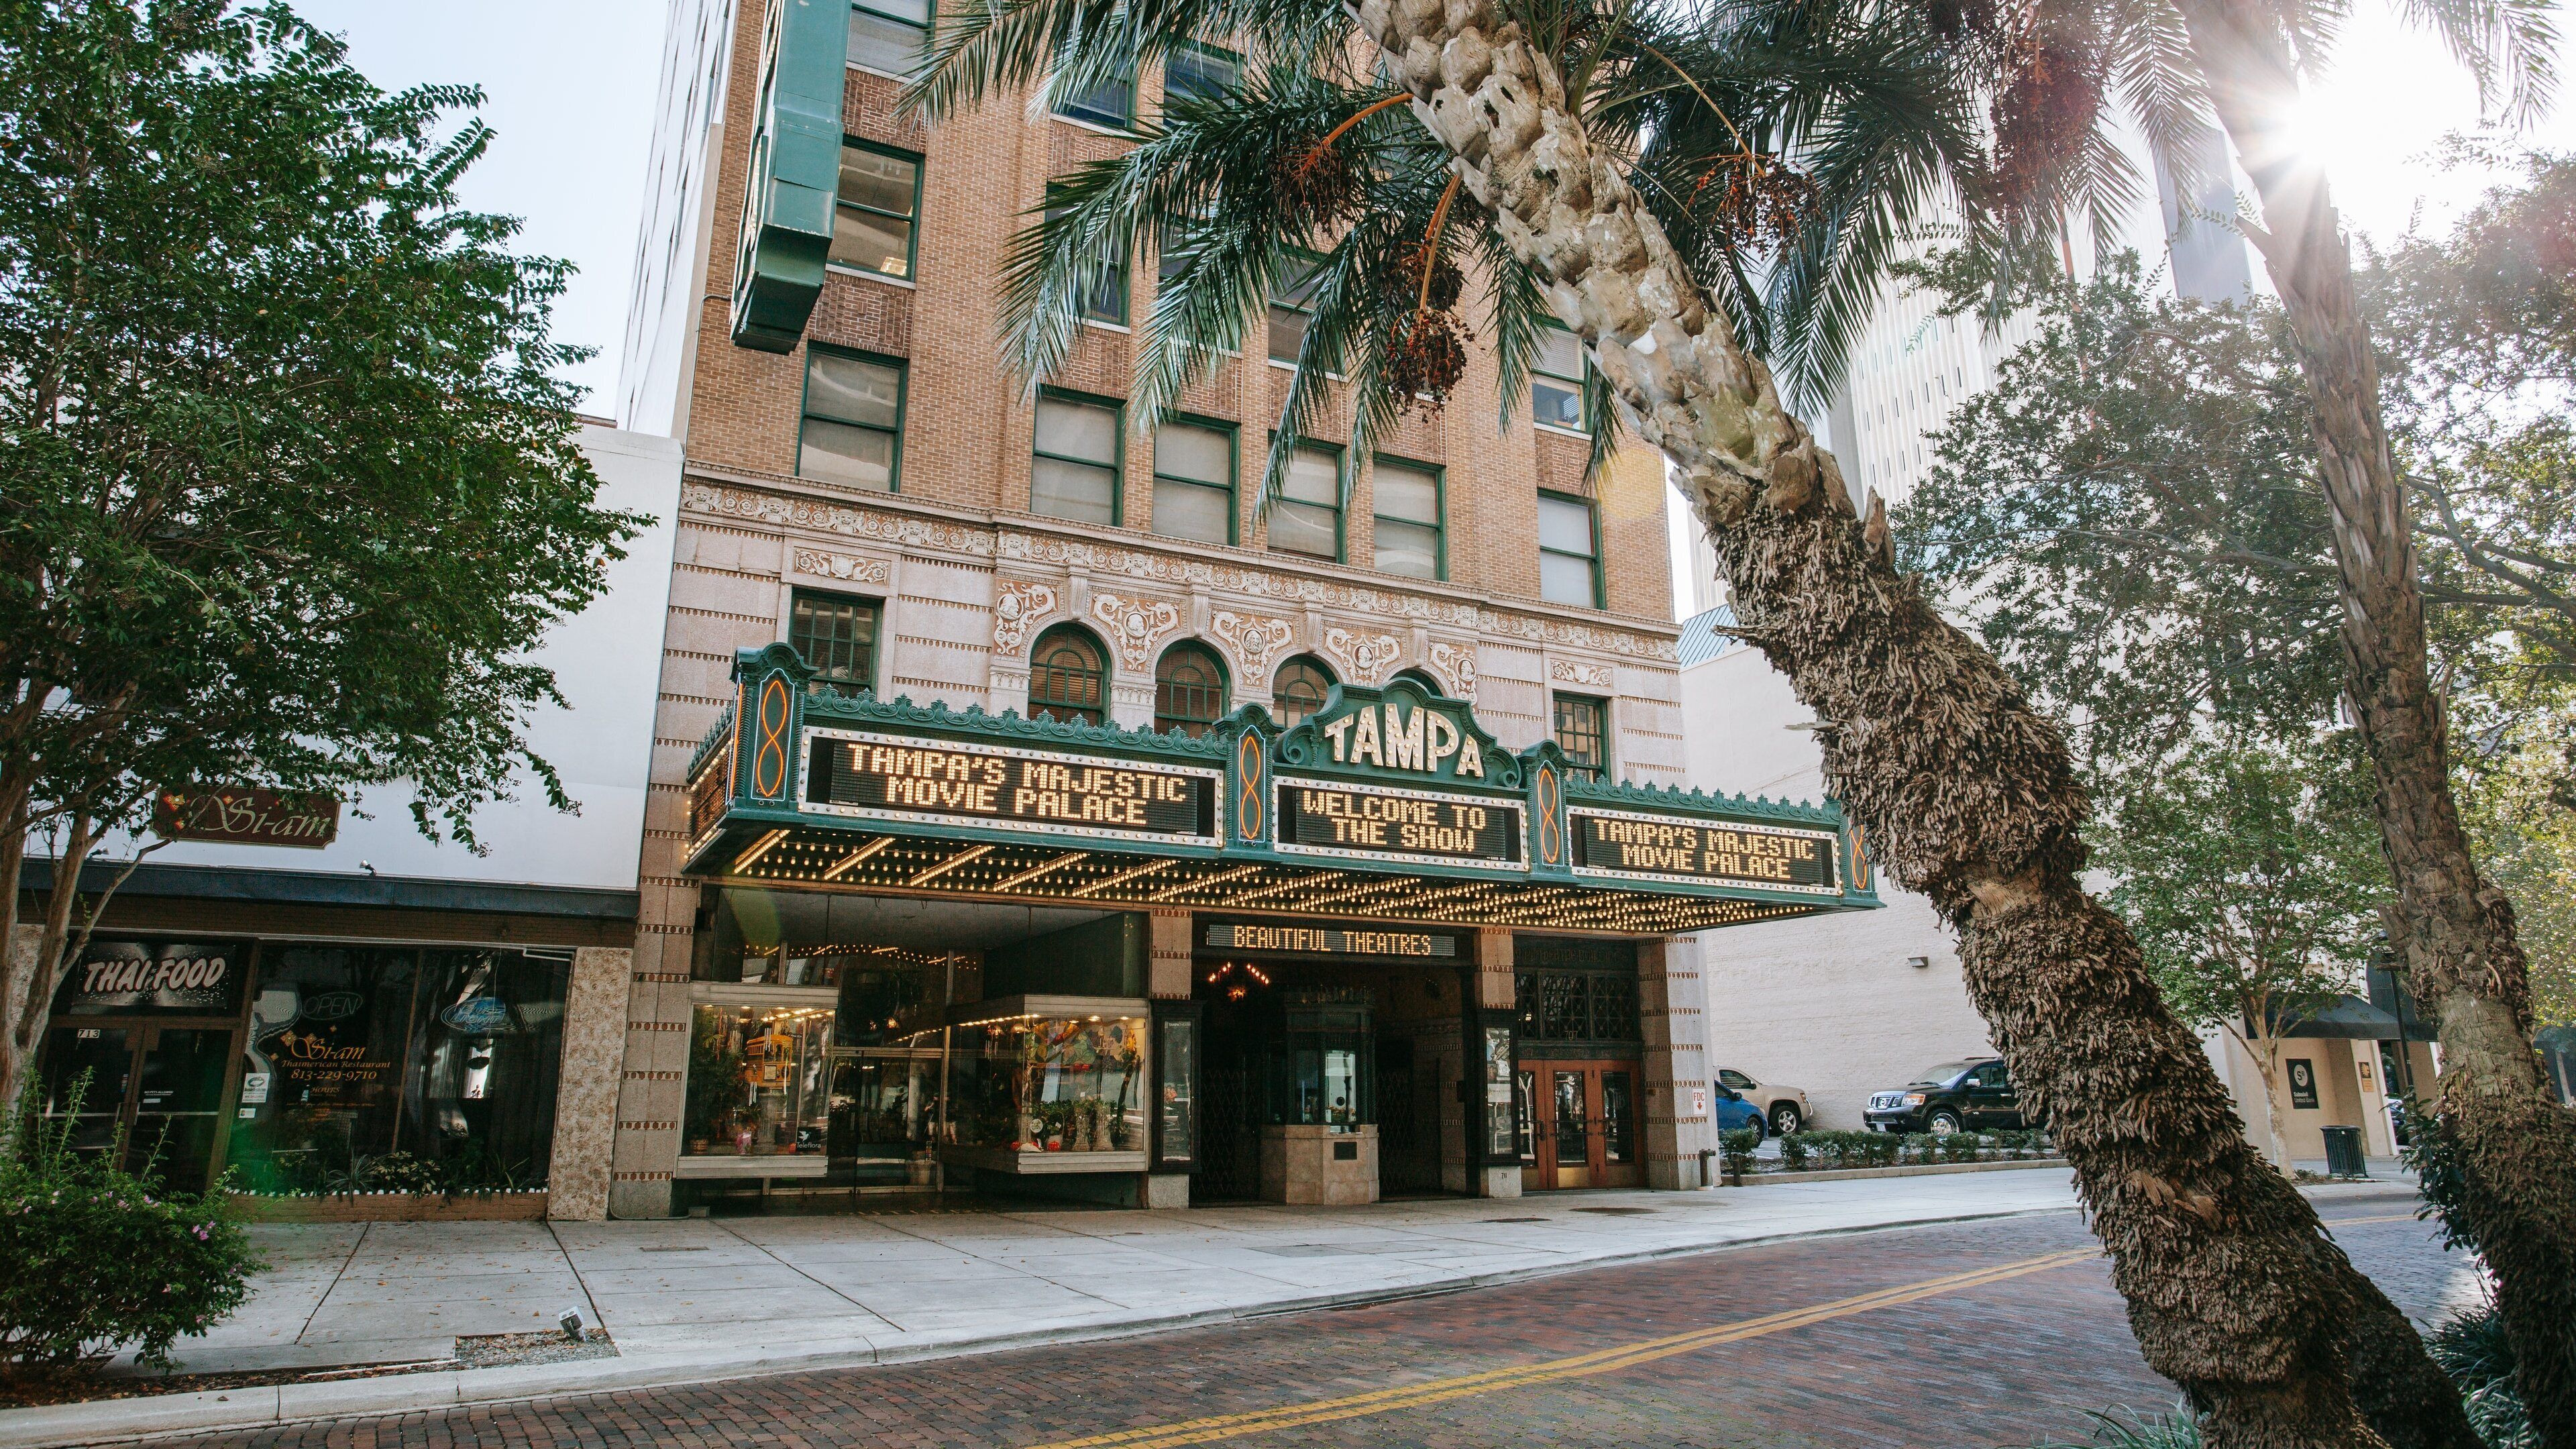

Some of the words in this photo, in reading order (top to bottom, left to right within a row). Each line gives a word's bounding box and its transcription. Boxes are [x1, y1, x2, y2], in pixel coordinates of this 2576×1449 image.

[1325, 704, 1484, 777] TAMPA
[848, 743, 1005, 785] TAMPA'S
[1023, 761, 1186, 802] MAJESTIC
[198, 794, 331, 838] Si-am
[887, 776, 998, 812] MOVIE
[1015, 788, 1146, 825] PALACE
[1303, 790, 1438, 826] WELCOME
[1451, 805, 1486, 829] TO
[1332, 818, 1387, 845] THE
[1401, 824, 1474, 852] SHOW
[1593, 819, 1697, 849] TAMPA'S
[1707, 830, 1815, 859] MAJESTIC
[1622, 845, 1695, 871] MOVIE
[1705, 852, 1791, 879] PALACE
[1234, 926, 1331, 951] BEAUTIFUL
[1342, 931, 1431, 955] THEATRES
[83, 958, 152, 994] THAI
[152, 957, 226, 991] FOOD
[304, 997, 359, 1014] OPEN
[78, 1030, 99, 1038] 713
[291, 1037, 366, 1060] Si-am
[1564, 1030, 1578, 1041] 707
[290, 1069, 377, 1081] 813-229-9710
[1693, 1092, 1705, 1102] FDC
